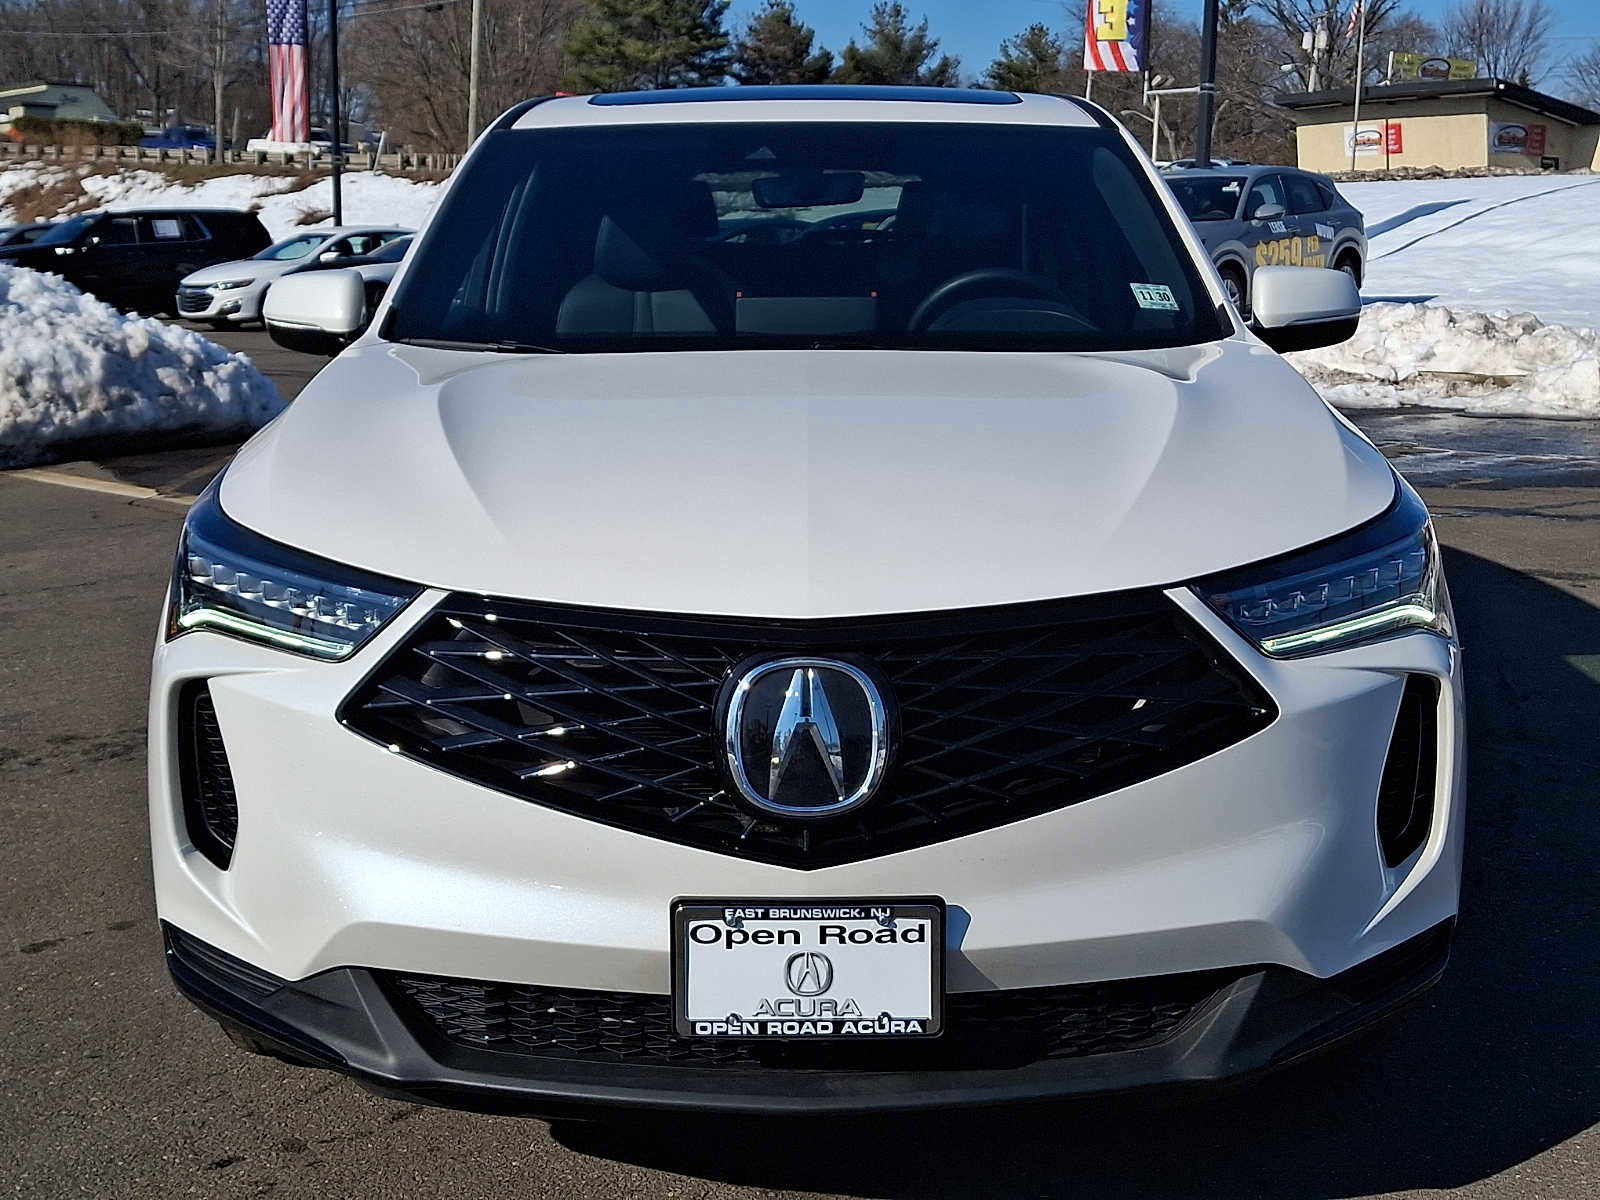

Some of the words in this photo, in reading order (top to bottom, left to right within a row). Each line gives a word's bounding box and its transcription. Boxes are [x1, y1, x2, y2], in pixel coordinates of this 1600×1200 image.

[1139, 290, 1154, 301] 11
[1155, 291, 1170, 302] 30
[725, 908, 764, 919] EAST
[871, 907, 891, 918] NJ
[690, 924, 801, 949] Open
[819, 923, 926, 945] Road
[752, 998, 862, 1017] ACURA
[695, 1021, 759, 1035] OPEN
[767, 1021, 834, 1035] ROAD
[841, 1020, 923, 1034] ACURA
